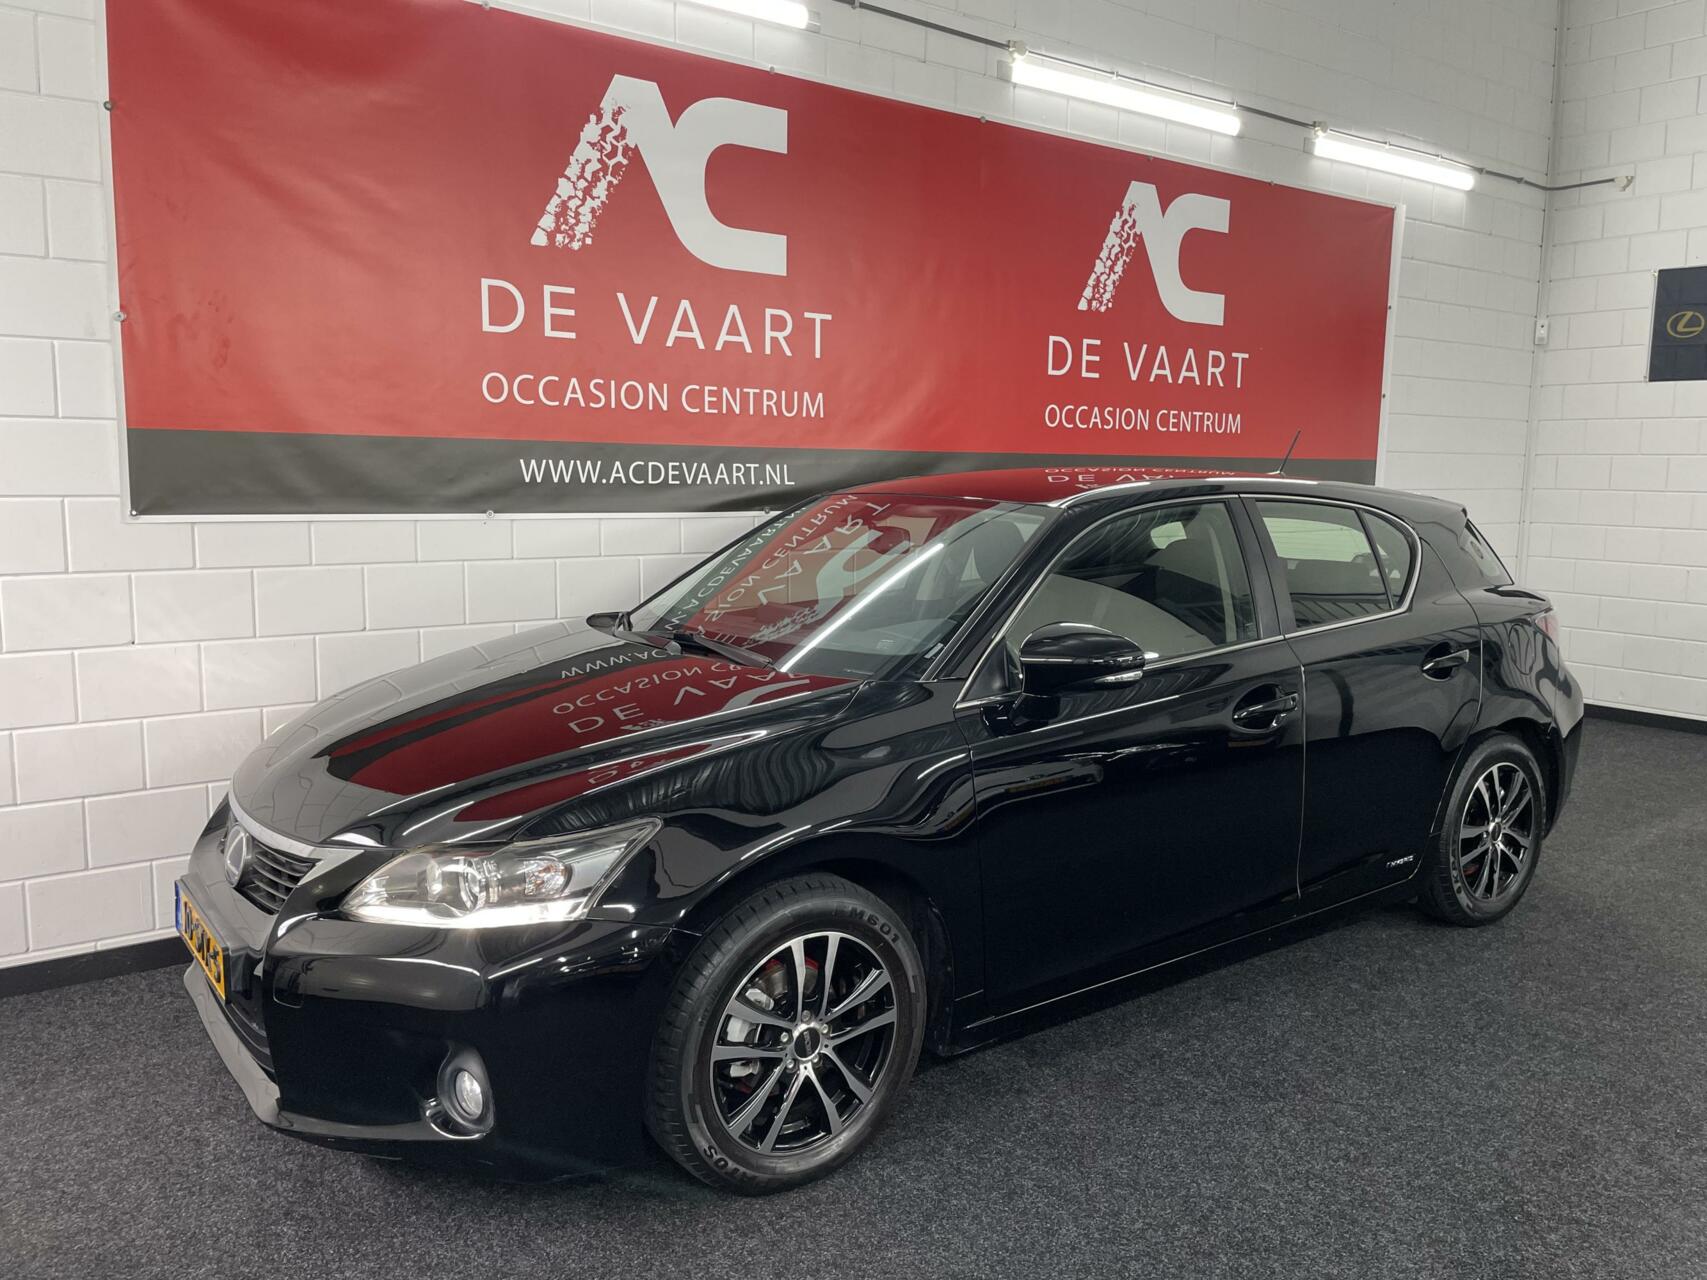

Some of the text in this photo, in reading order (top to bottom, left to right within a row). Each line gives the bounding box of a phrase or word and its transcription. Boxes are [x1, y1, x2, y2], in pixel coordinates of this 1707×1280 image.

[480, 277, 833, 359] DE VAART
[1047, 335, 1249, 388] DE VAART
[482, 372, 825, 418] OCCASION CENTRUM
[1045, 404, 1241, 434] OCCASION CENTRUM
[520, 458, 796, 486] WWW.ACDEVAART.NL
